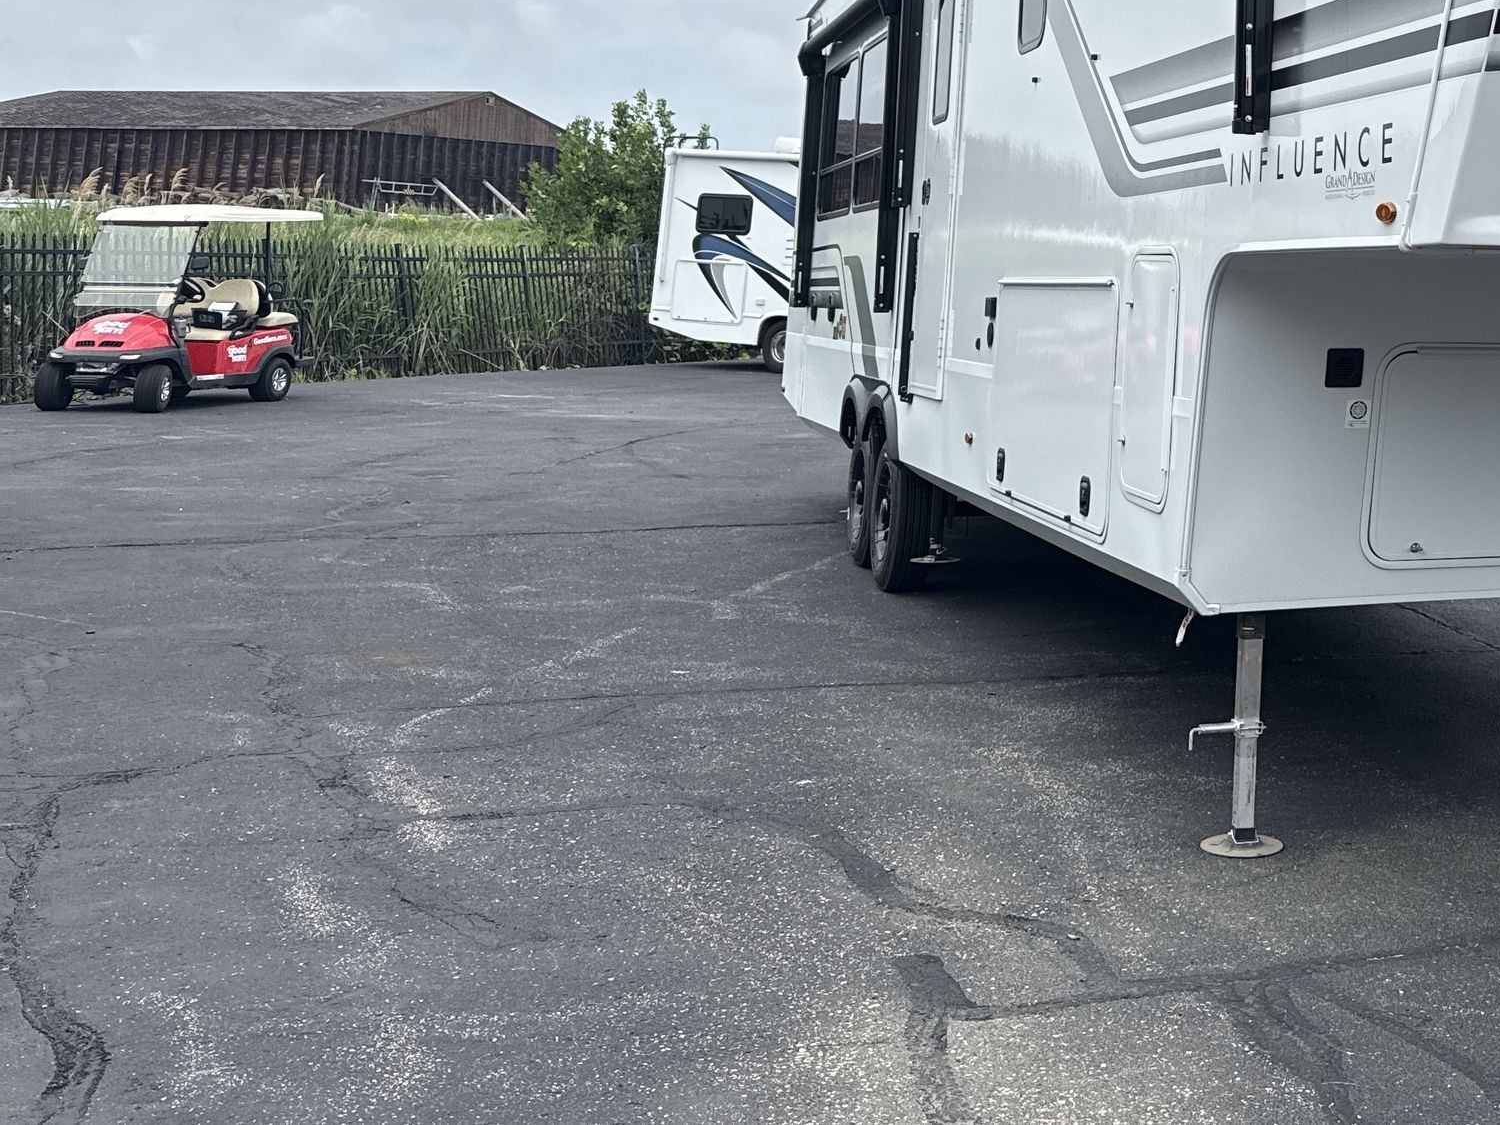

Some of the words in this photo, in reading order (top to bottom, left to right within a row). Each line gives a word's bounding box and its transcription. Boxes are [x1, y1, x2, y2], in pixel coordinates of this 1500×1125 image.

[1229, 122, 1393, 188] INFLUENCE
[1325, 174, 1346, 189] GRAND
[1353, 170, 1376, 186] DESIGN
[227, 344, 247, 358] good
